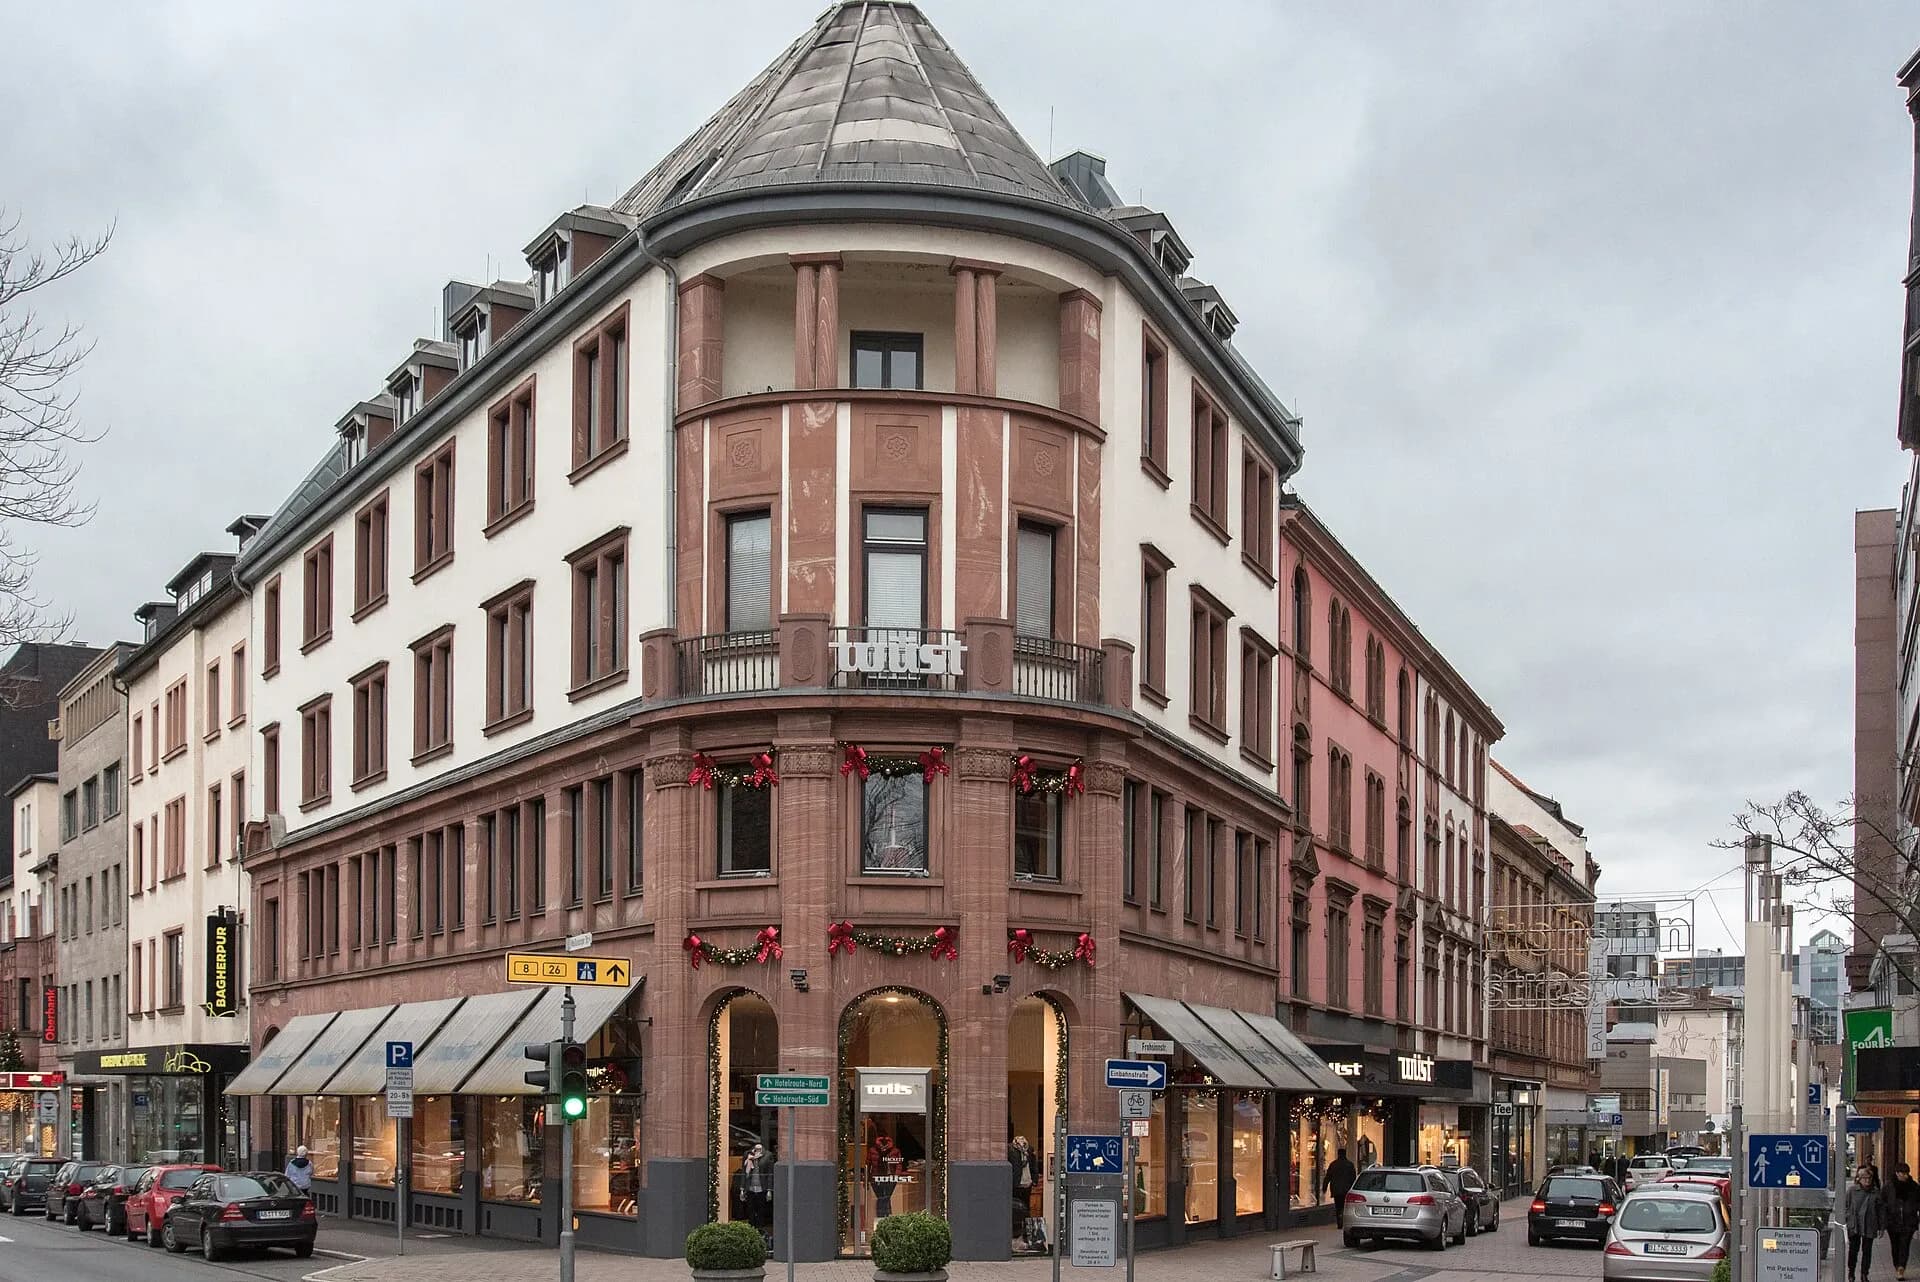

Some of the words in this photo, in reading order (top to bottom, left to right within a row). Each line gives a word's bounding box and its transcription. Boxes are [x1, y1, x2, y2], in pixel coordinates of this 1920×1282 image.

[216, 926, 227, 1008] BAGHERPUR
[523, 964, 529, 973] 8
[549, 965, 561, 975] 26
[45, 988, 56, 1041] Oberbank
[1852, 1040, 1878, 1050] FOUR
[392, 1045, 407, 1064] P
[1398, 1054, 1435, 1082] wüst
[1110, 1070, 1150, 1079] Einbahnstraße
[774, 1079, 822, 1088] Hotelroute-Nord
[773, 1095, 820, 1103] Hotelroute-Süd
[1496, 1104, 1511, 1113] Tee
